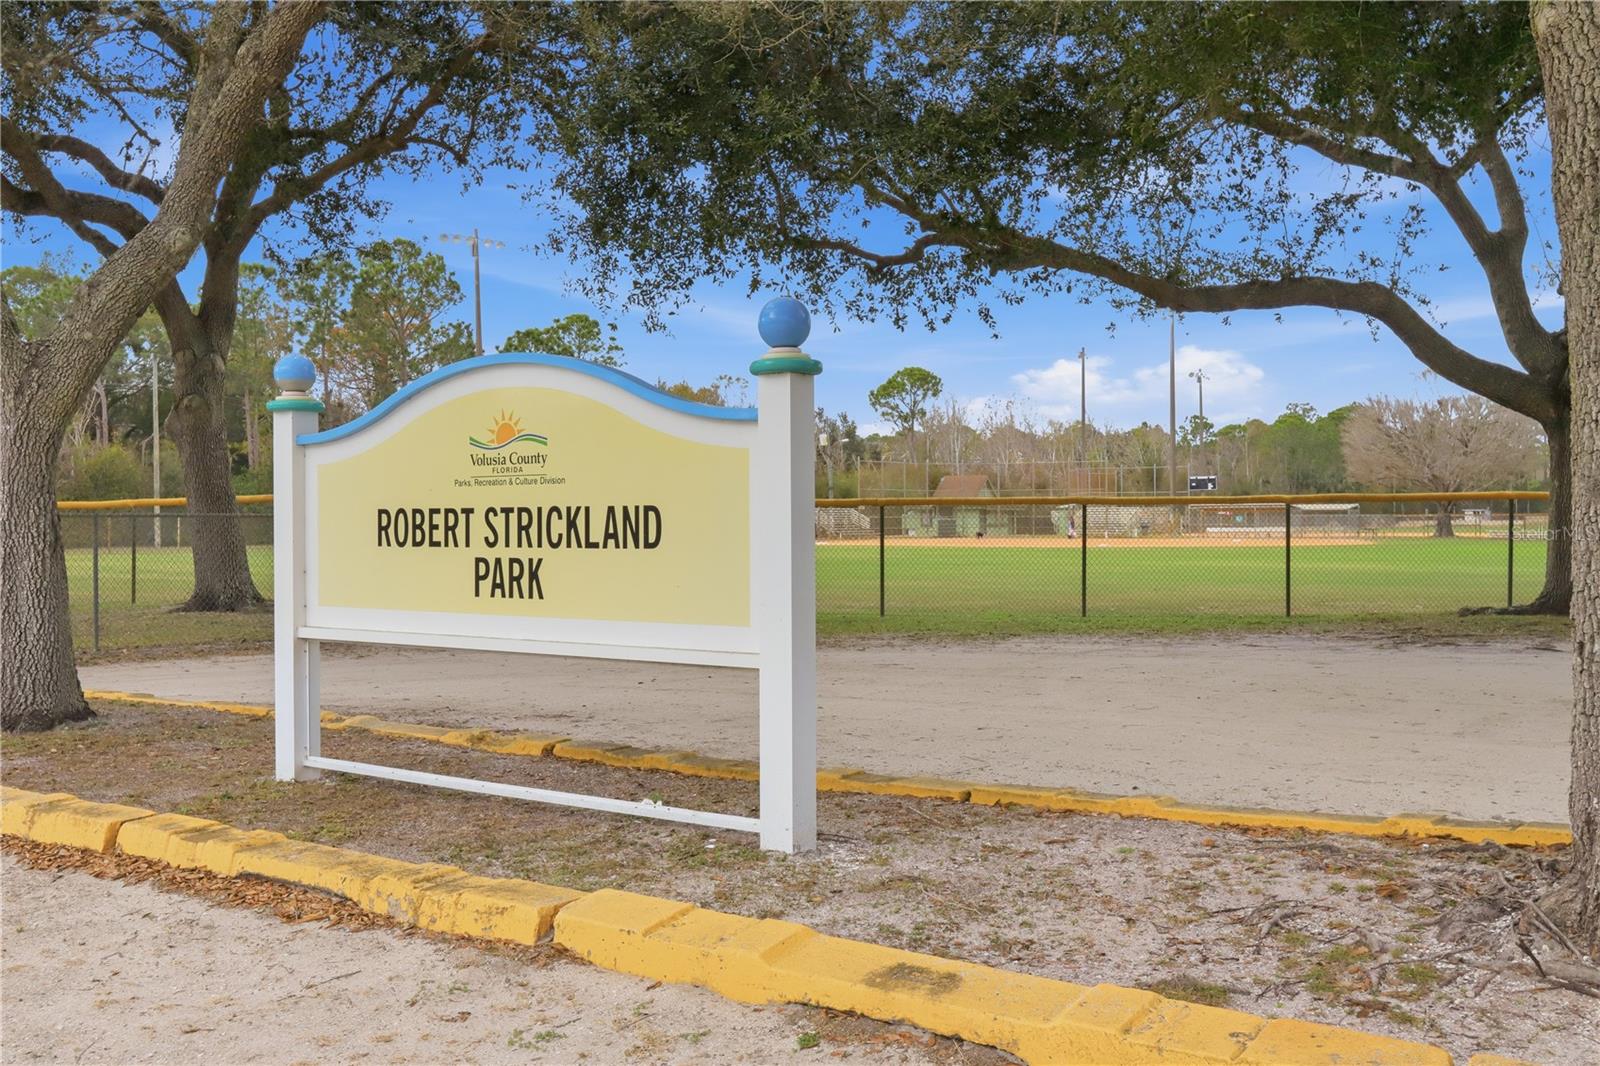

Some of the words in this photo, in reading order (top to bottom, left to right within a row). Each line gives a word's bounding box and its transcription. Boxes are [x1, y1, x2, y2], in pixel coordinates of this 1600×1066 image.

[470, 453, 506, 466] Volusia
[509, 451, 548, 468] County
[454, 479, 473, 487] Parks,
[474, 478, 507, 487] Recreation
[508, 478, 513, 486] &
[514, 477, 538, 486] Culture
[540, 476, 566, 485] Division
[377, 507, 474, 548] ROBERT
[484, 505, 662, 549] STRICKLAND
[474, 557, 544, 600] PARK
